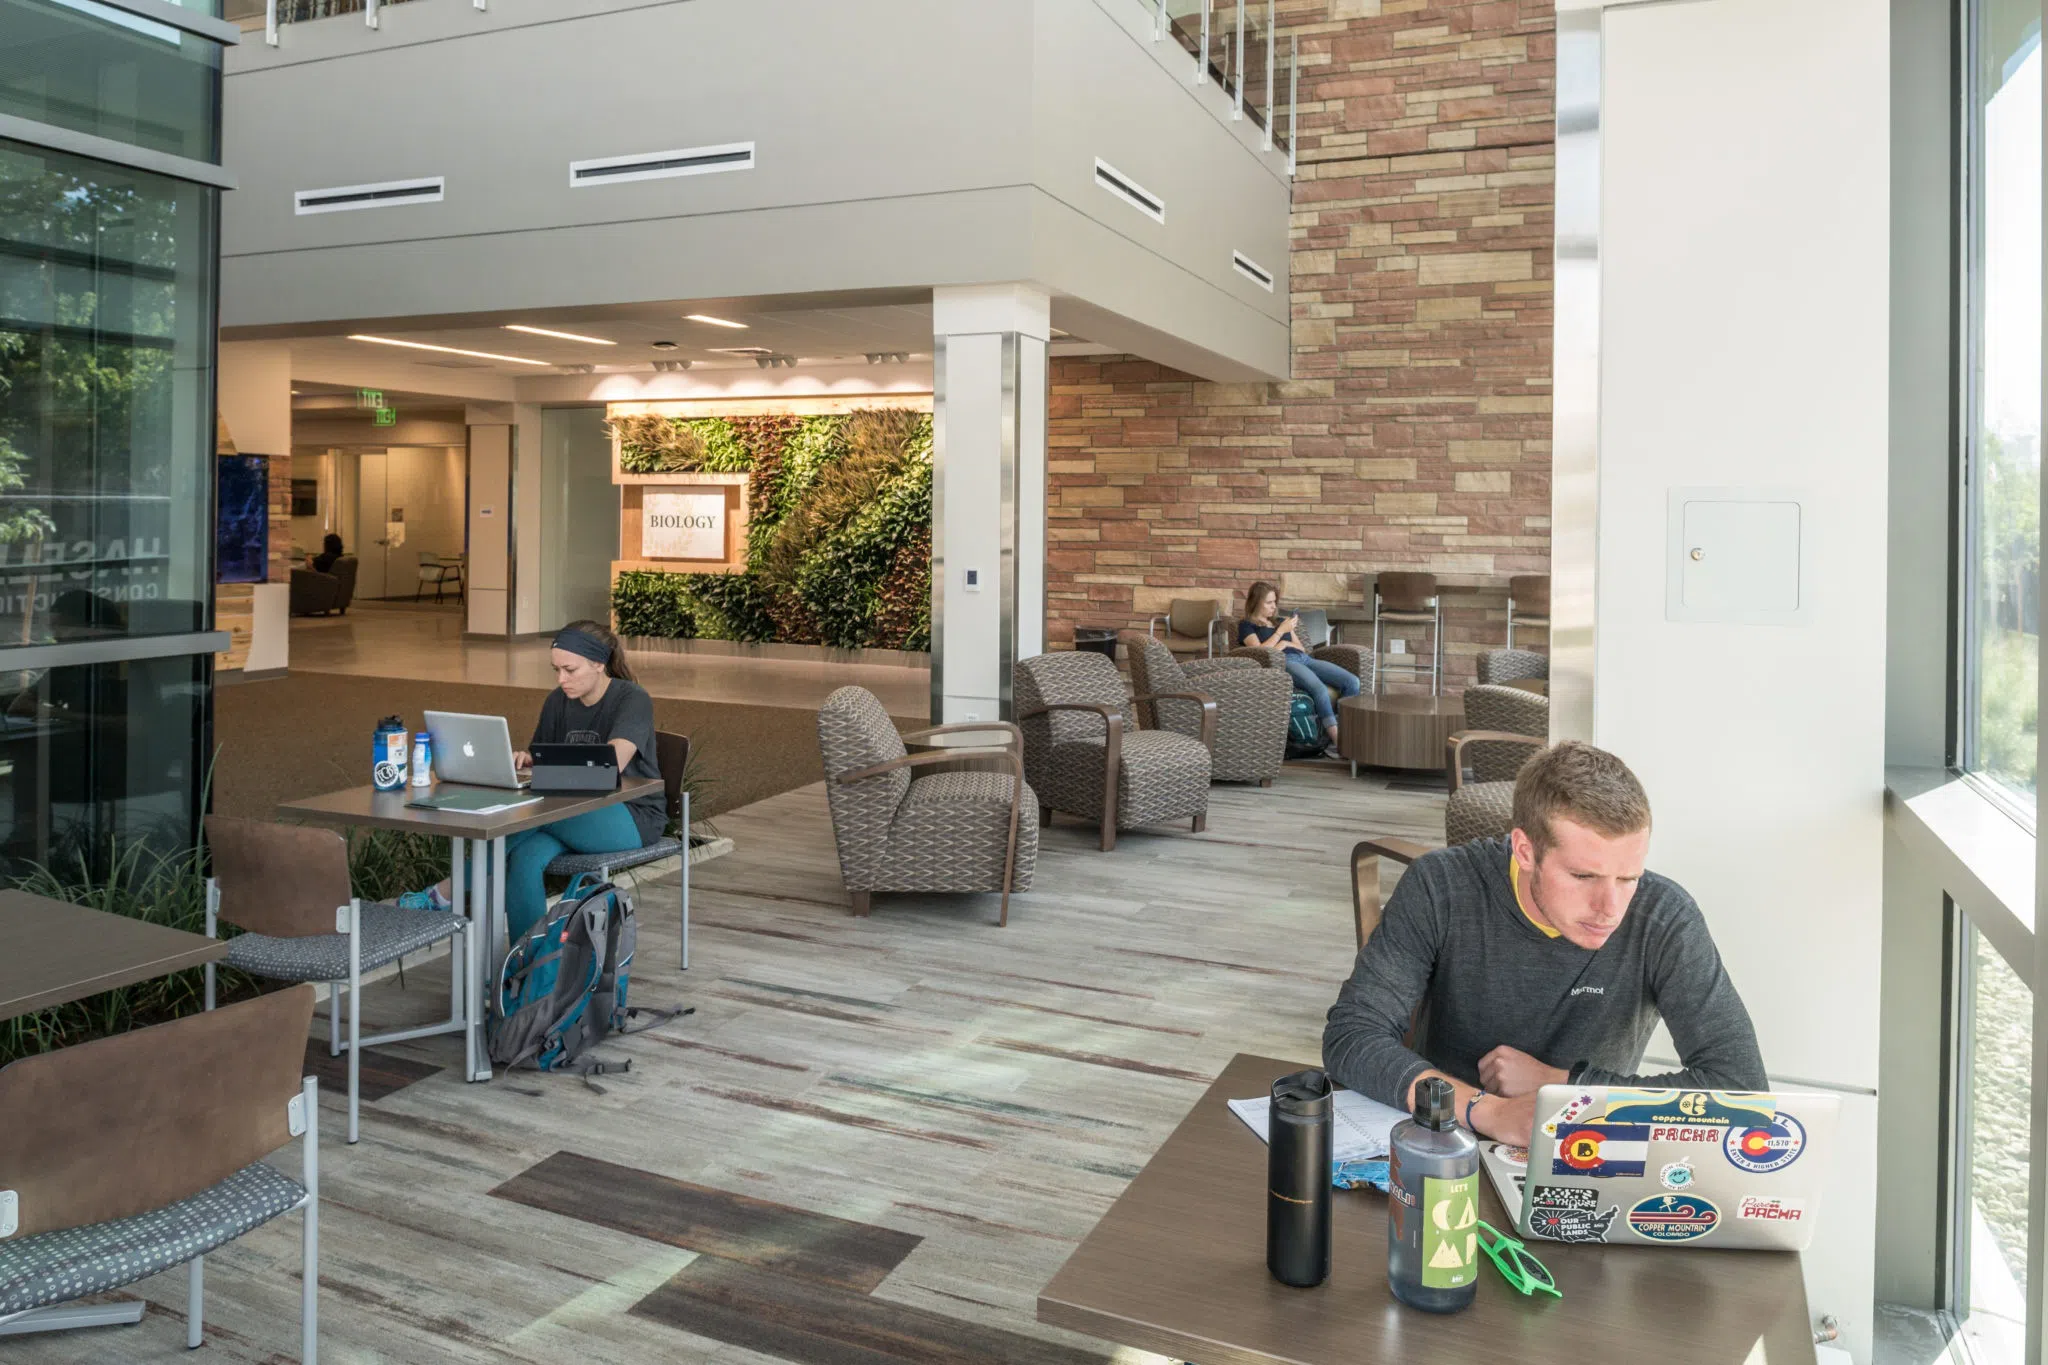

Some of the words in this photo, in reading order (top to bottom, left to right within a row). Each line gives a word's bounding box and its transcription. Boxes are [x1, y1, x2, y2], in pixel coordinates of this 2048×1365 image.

[650, 515, 716, 529] BIOLOGY
[1652, 1115, 1686, 1123] copper
[1688, 1116, 1730, 1124] mountain
[1652, 1127, 1719, 1142] PACHA
[1730, 1148, 1746, 1164] ENTER
[1753, 1161, 1780, 1169] HIGHER
[1780, 1148, 1798, 1163] STATE
[1741, 1197, 1770, 1208] Pure
[1743, 1207, 1802, 1220] PACHA
[1561, 1222, 1591, 1230] PUBLIC
[1638, 1223, 1665, 1232] COPPER
[1667, 1224, 1707, 1232] MOUNTAIN
